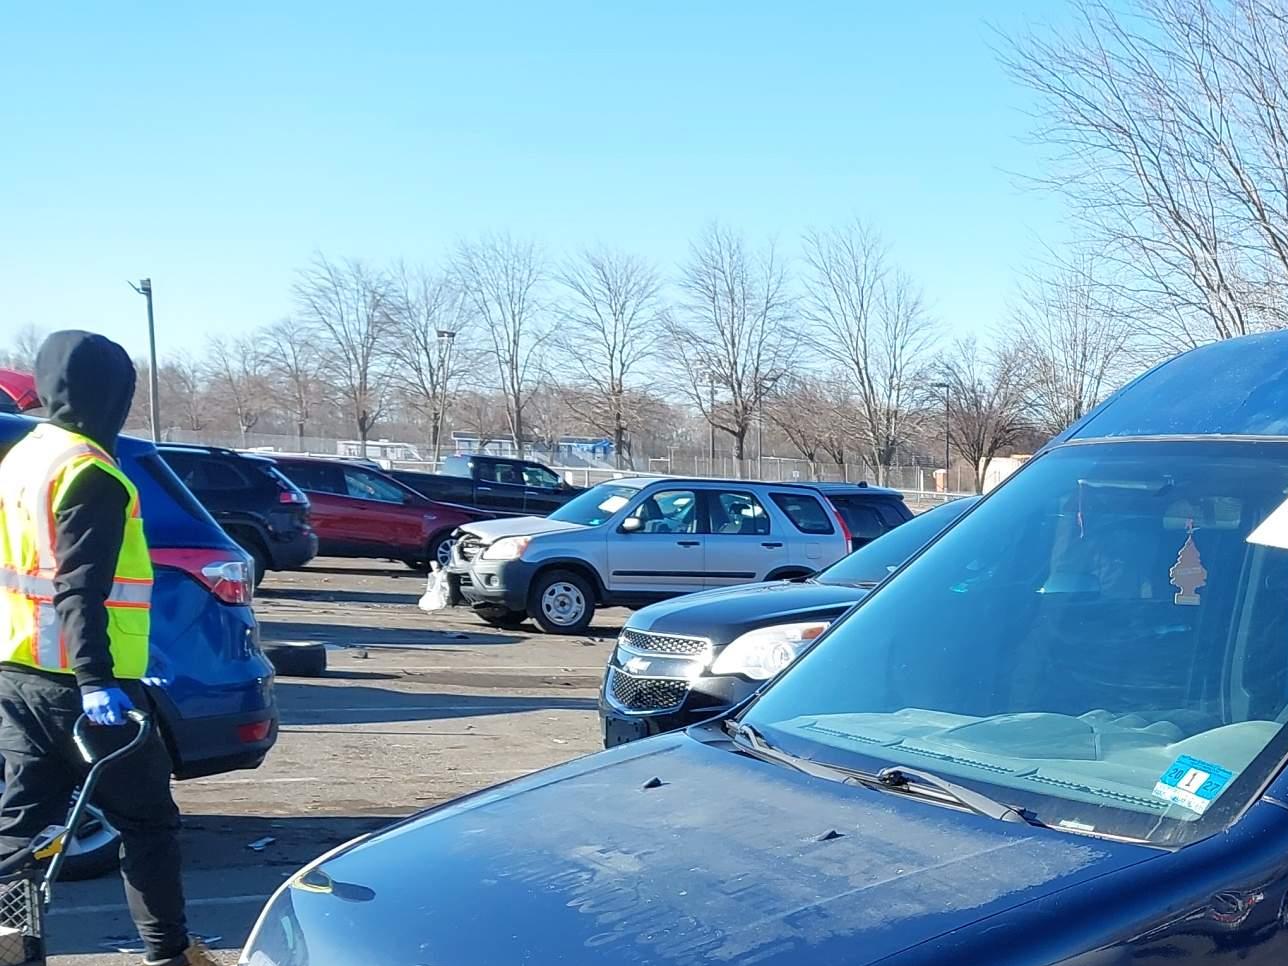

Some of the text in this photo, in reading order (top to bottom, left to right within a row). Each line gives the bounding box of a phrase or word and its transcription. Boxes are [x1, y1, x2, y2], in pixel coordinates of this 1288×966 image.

[1168, 767, 1221, 793] 20 1 27
